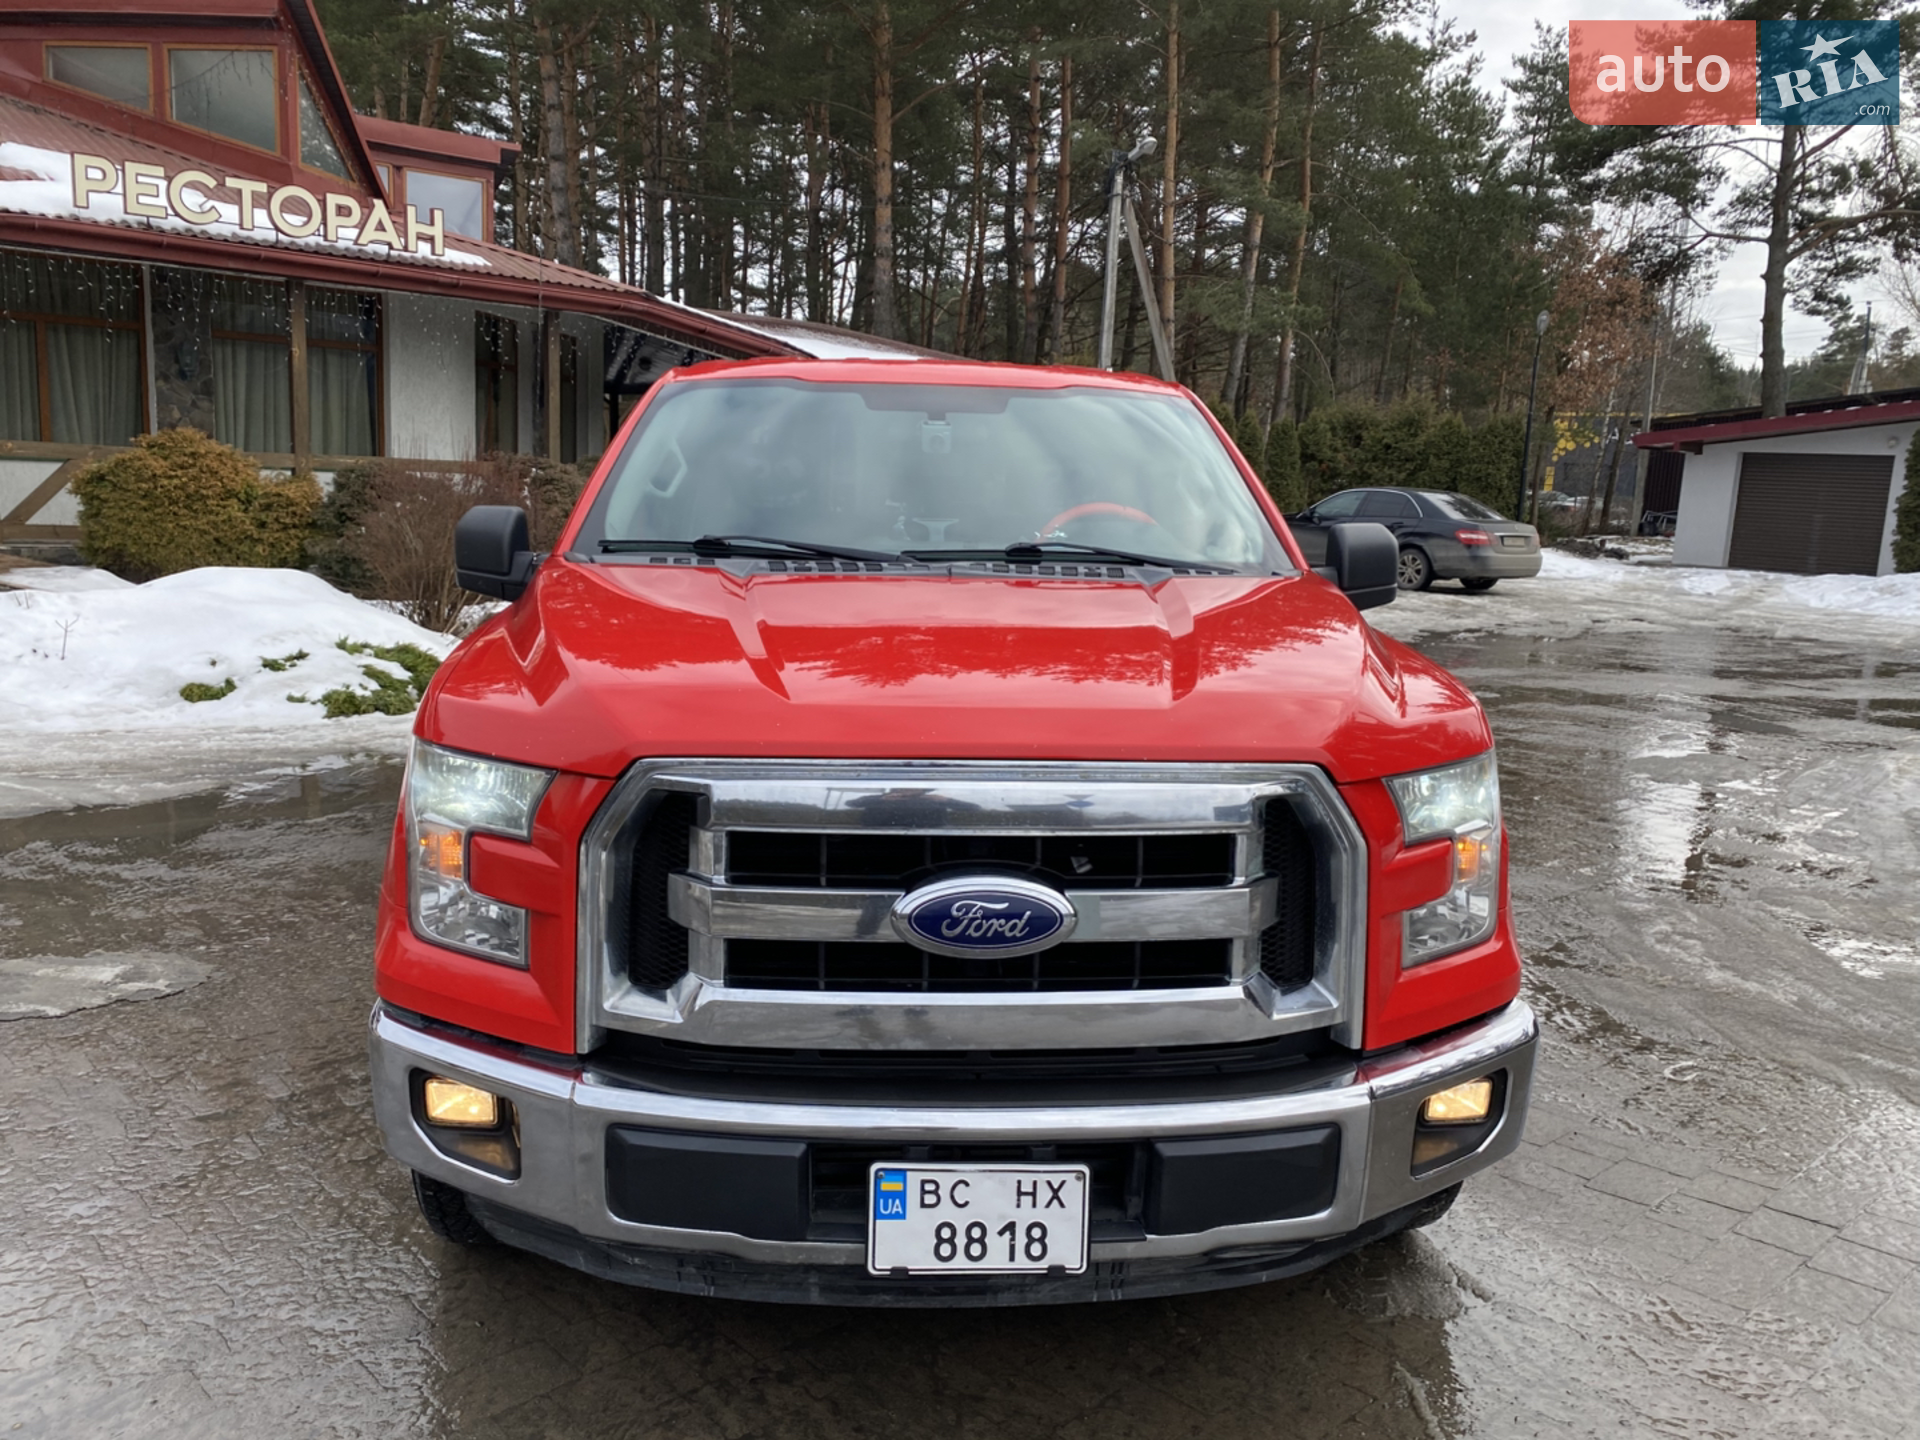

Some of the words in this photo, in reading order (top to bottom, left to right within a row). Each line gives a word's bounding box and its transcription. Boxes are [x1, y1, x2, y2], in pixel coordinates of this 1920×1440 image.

[71, 151, 446, 257] РЕСТОРАН
[940, 899, 1032, 938] Ford
[879, 1198, 904, 1215] UA
[919, 1178, 971, 1209] BC
[1015, 1179, 1067, 1209] HX
[932, 1220, 1049, 1263] 8818
